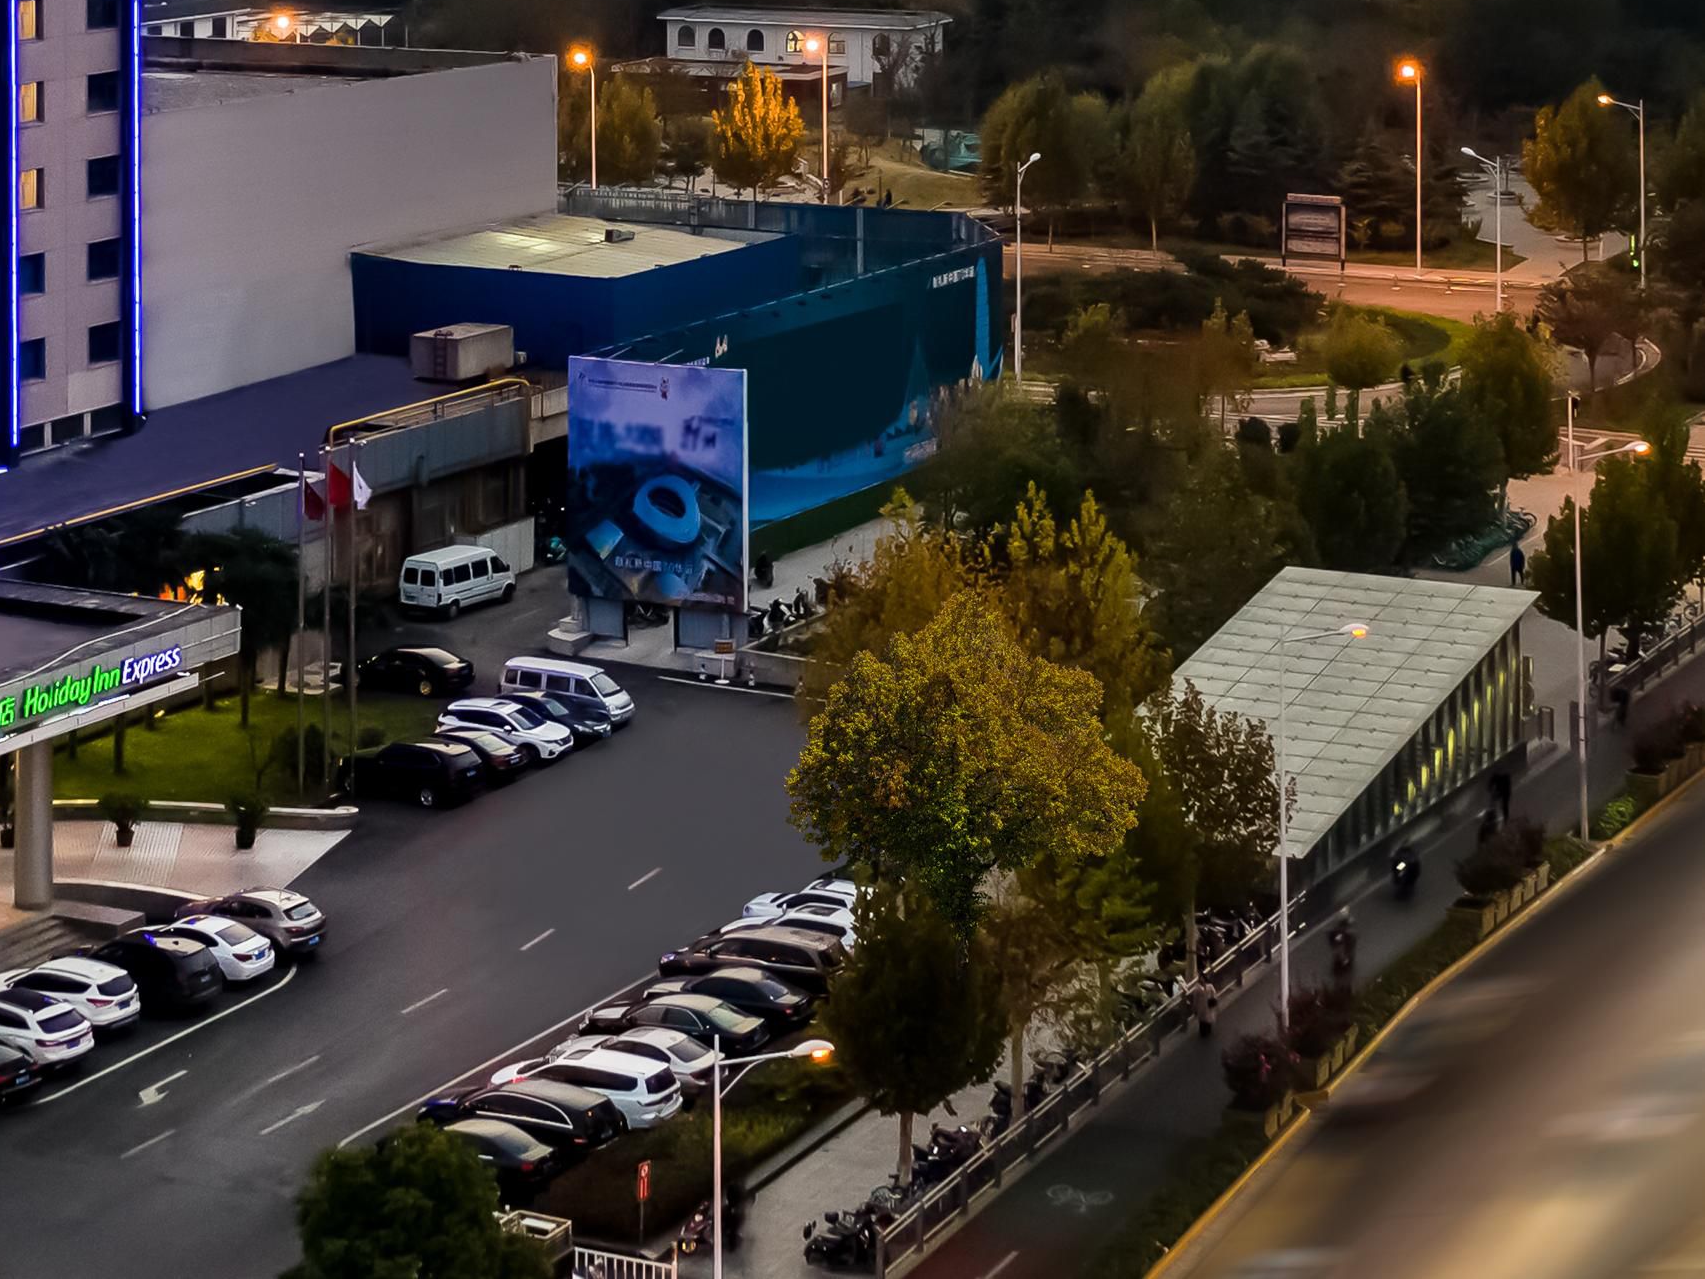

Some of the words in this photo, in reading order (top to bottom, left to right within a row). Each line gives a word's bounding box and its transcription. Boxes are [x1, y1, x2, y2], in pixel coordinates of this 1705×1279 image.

[25, 674, 92, 718] Holiday
[93, 665, 122, 694] Inn
[121, 645, 181, 685] Express
